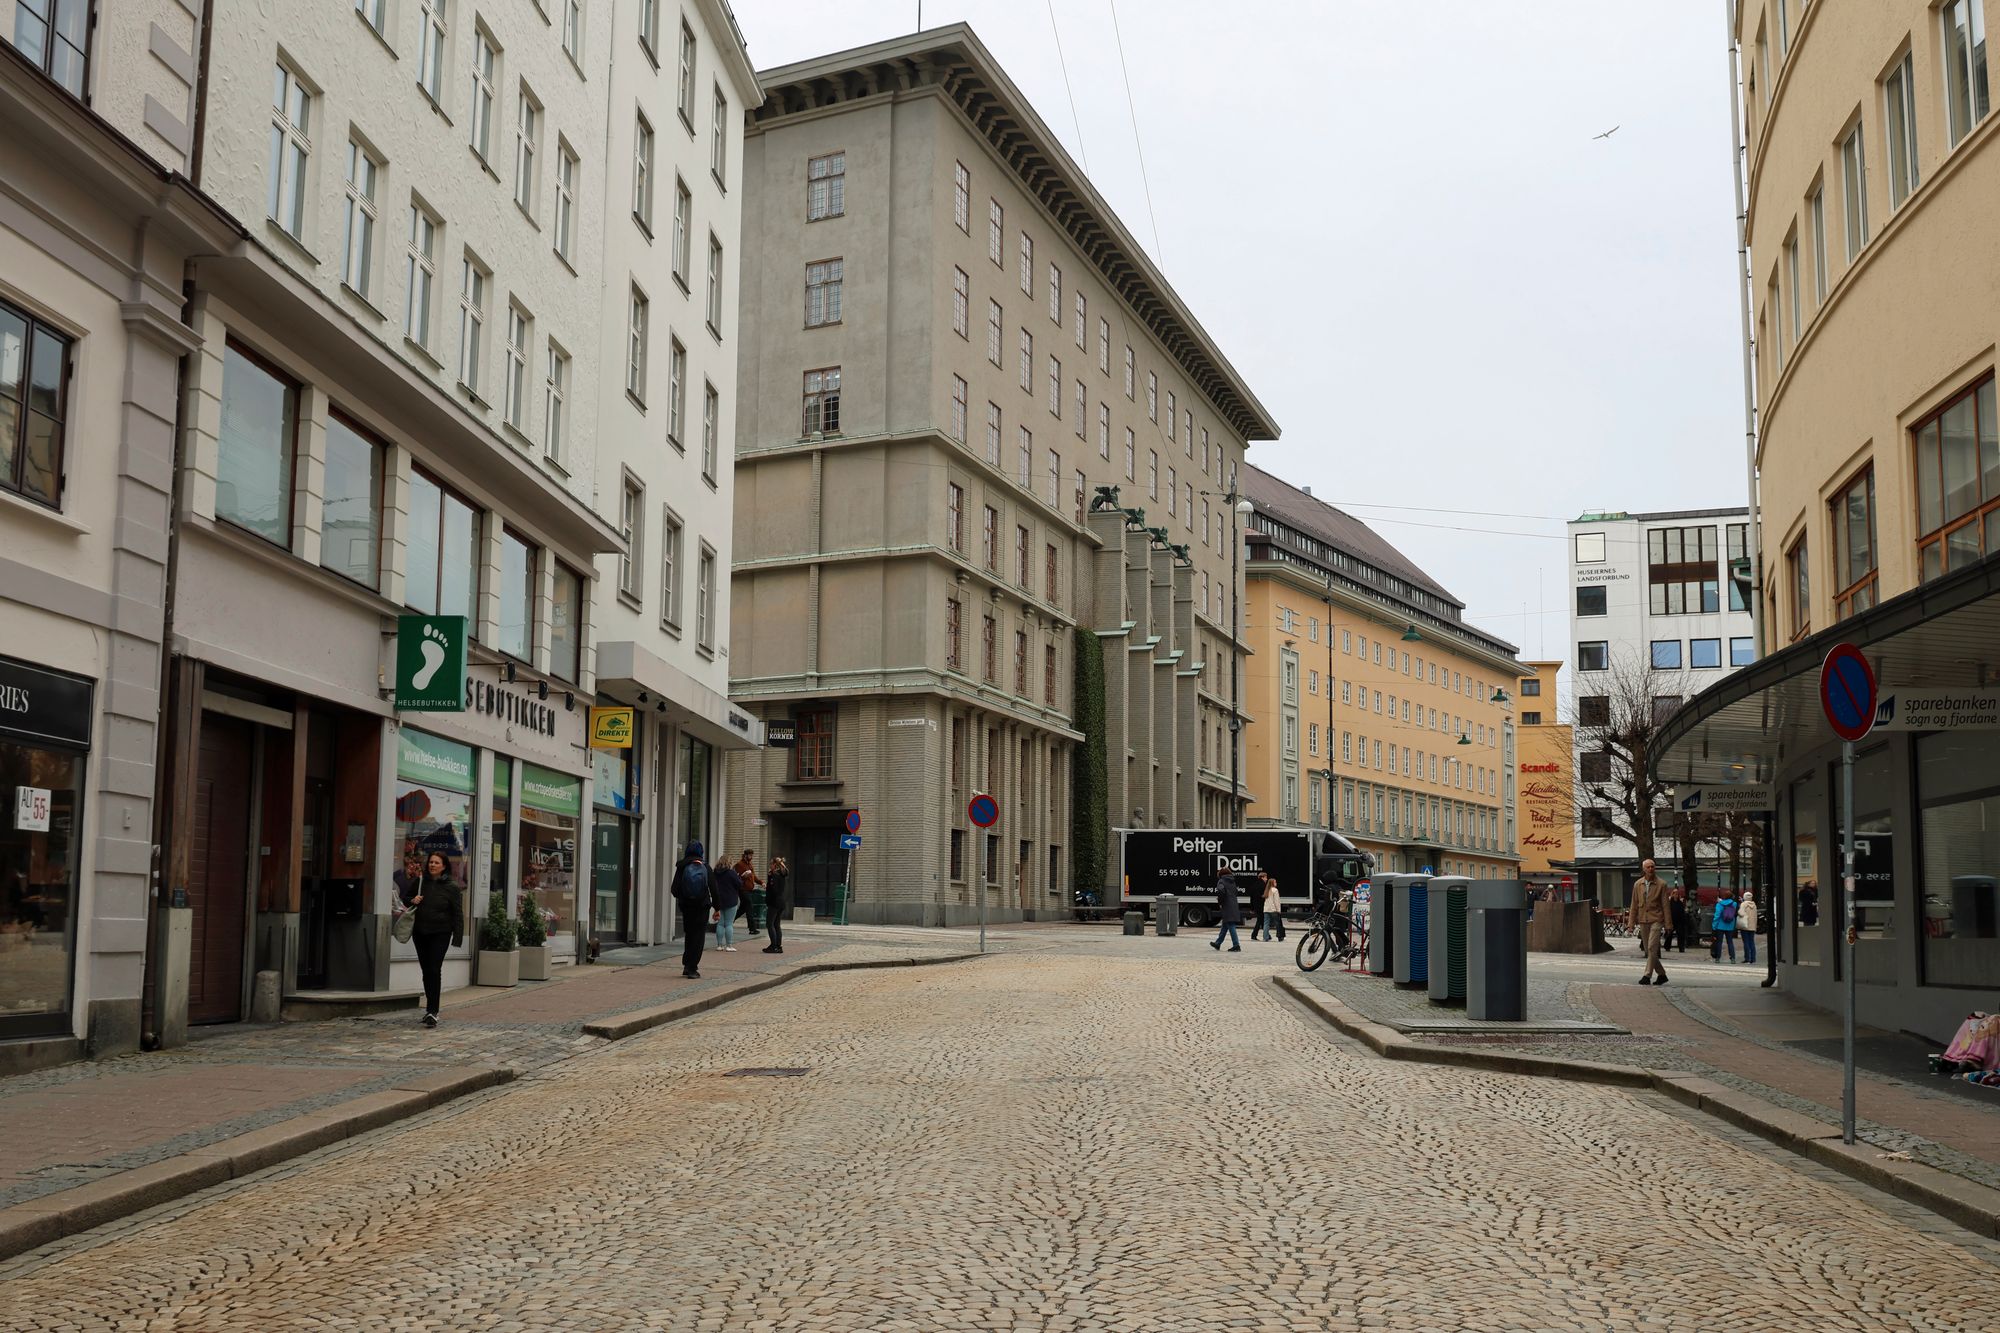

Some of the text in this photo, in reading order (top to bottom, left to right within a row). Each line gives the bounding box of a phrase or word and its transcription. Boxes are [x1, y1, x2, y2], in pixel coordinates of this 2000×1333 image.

[466, 676, 555, 737] SEBUTIKKEN
[1905, 696, 1996, 713] sparebanken
[1906, 712, 1997, 728] sogn og fjordane
[1521, 763, 1560, 773] Scandic
[1707, 788, 1767, 800] sparebanken
[1736, 800, 1767, 809] fjordane
[1174, 837, 1223, 852] Petter
[1217, 856, 1257, 870] Dahl
